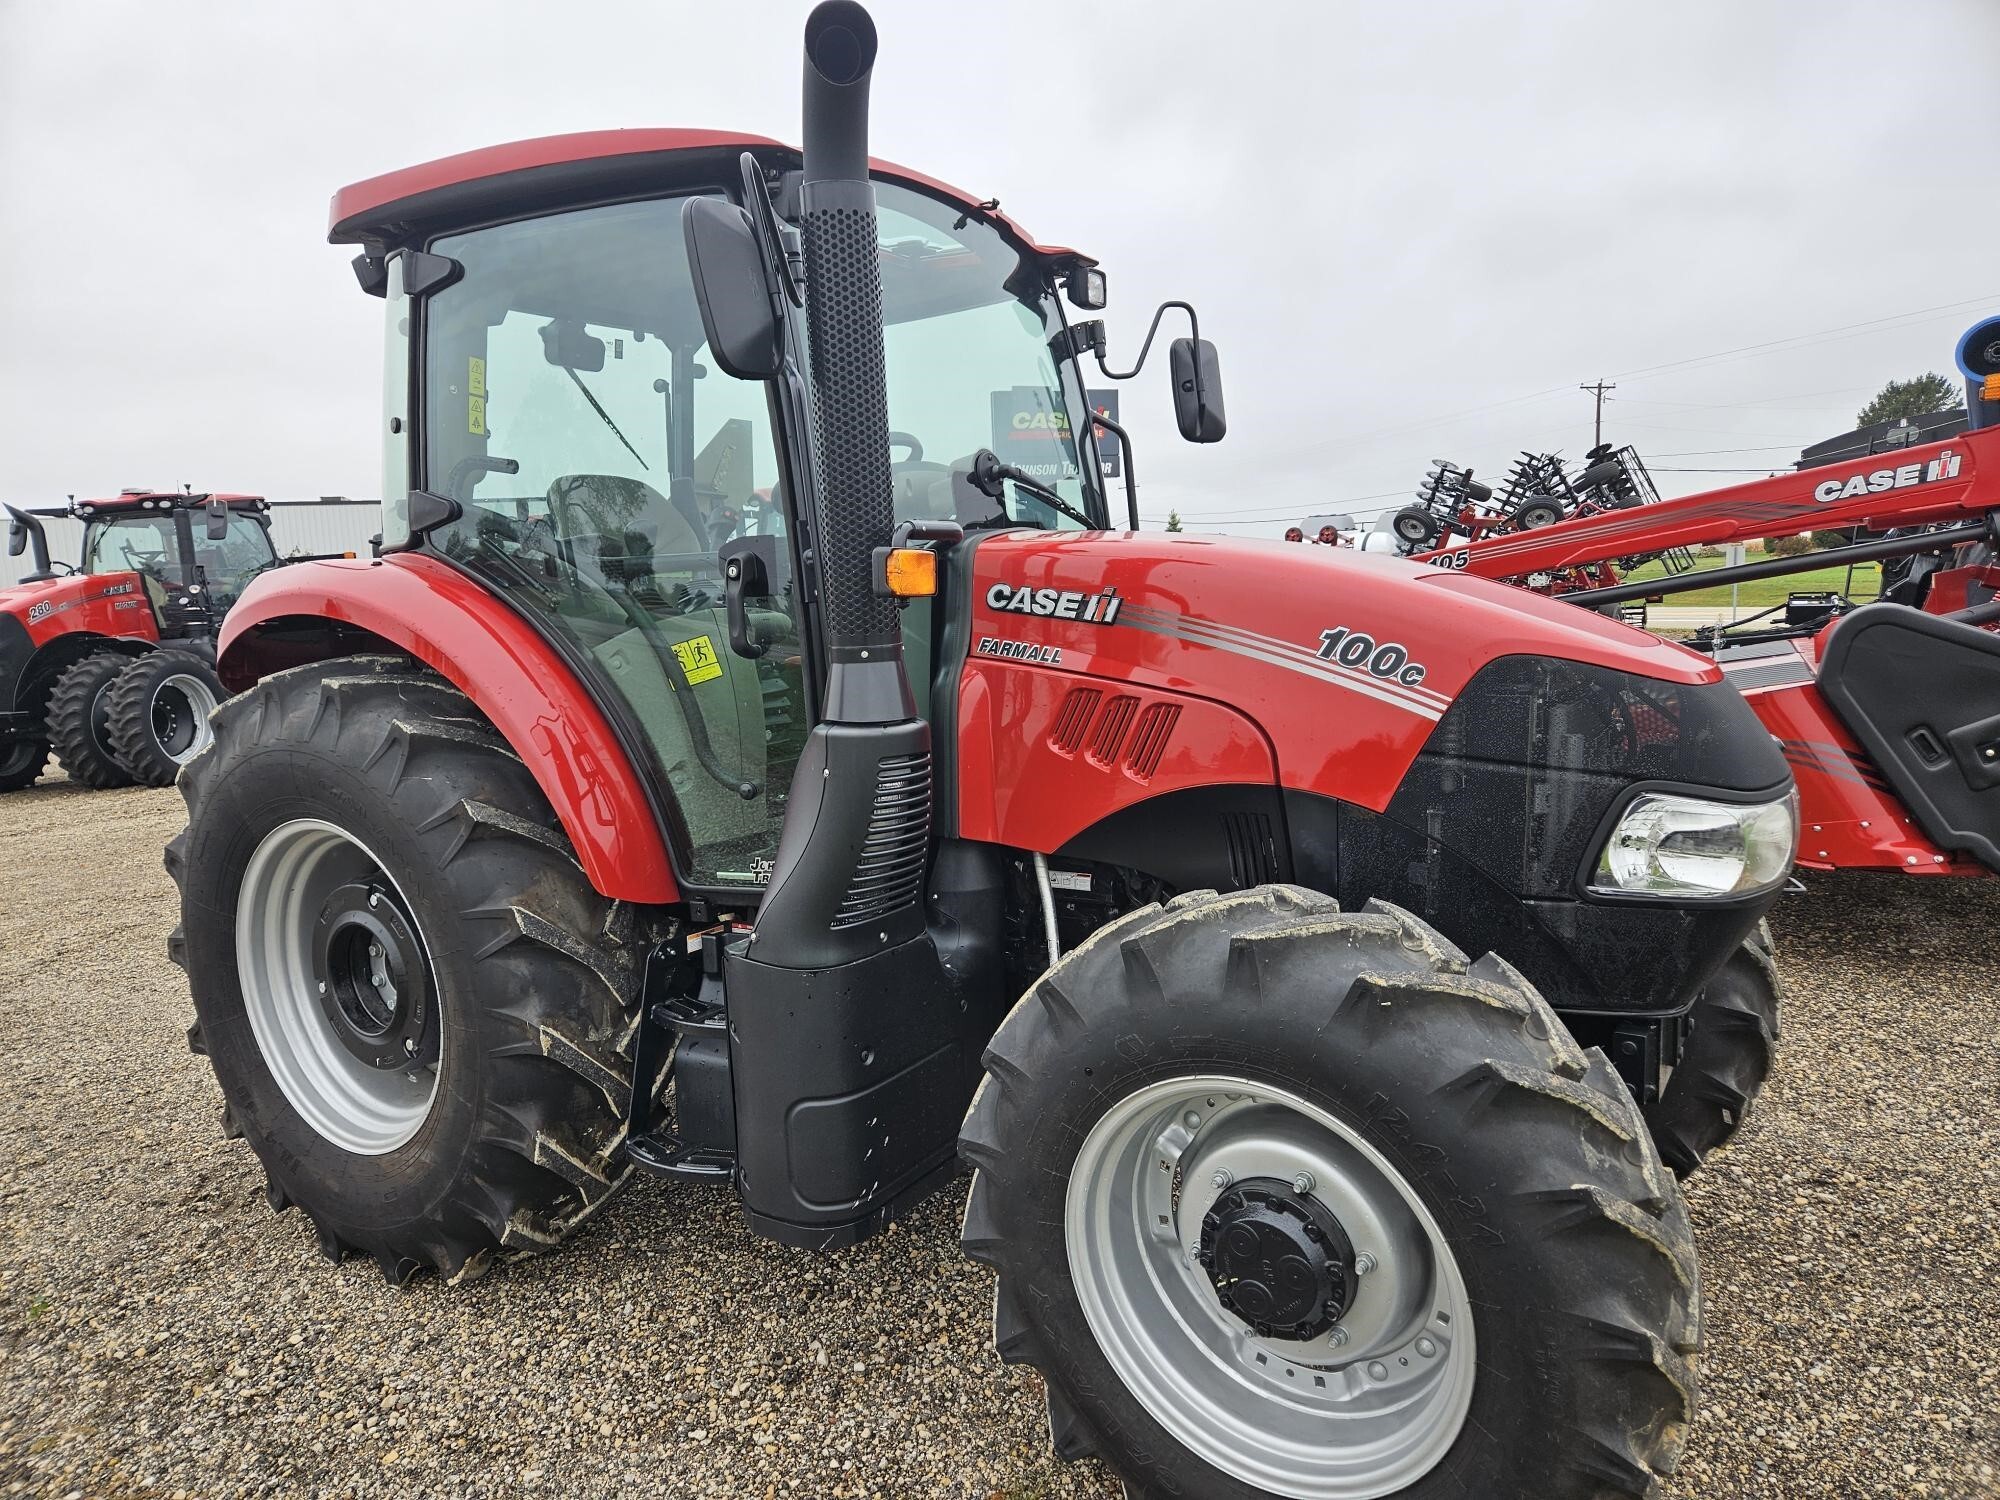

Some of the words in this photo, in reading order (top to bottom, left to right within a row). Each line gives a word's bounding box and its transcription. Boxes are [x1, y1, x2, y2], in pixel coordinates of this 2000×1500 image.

[1814, 463, 1922, 502] CASE
[29, 600, 51, 620] 280
[986, 583, 1084, 618] CASE
[976, 637, 1063, 665] FARMALL
